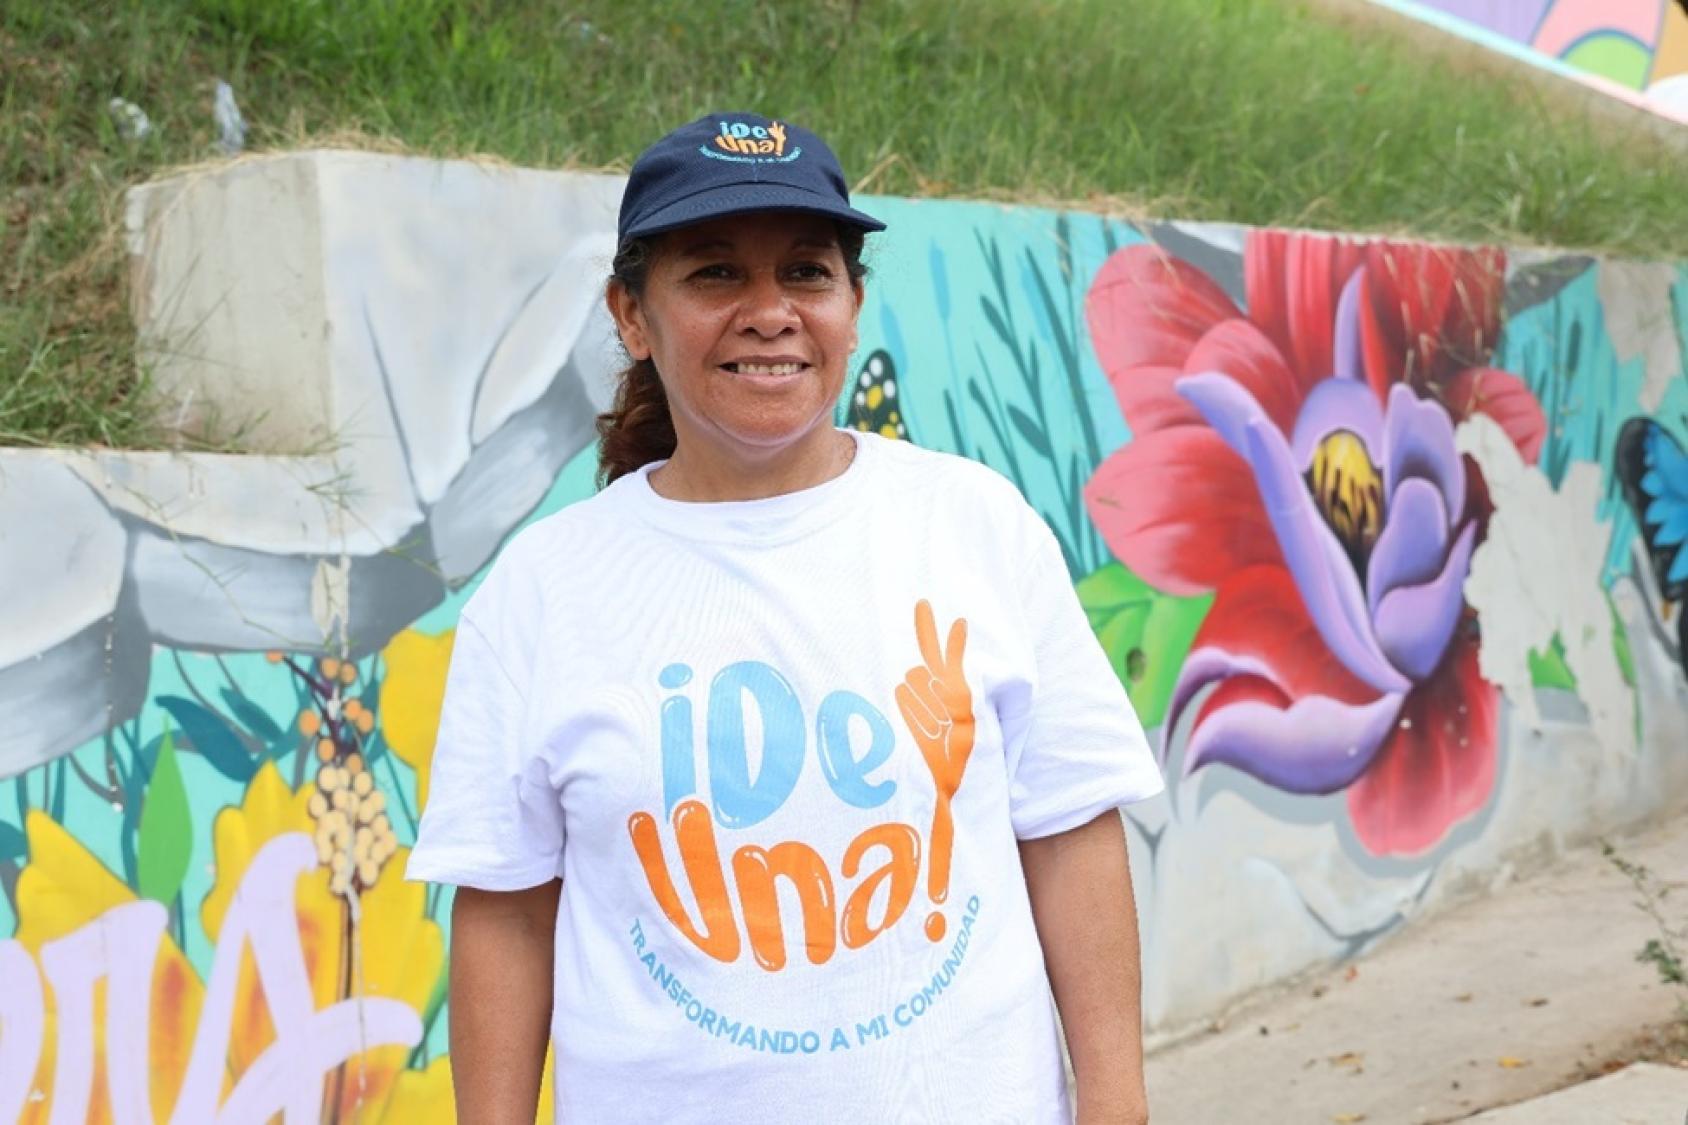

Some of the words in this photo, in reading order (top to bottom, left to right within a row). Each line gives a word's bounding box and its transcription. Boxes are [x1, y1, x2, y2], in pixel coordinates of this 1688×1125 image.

[629, 917, 821, 1055] TRANSFORMANDO
[830, 1026, 850, 1052] A
[856, 1015, 890, 1046] MI
[893, 893, 981, 1028] COMUNIDAD
